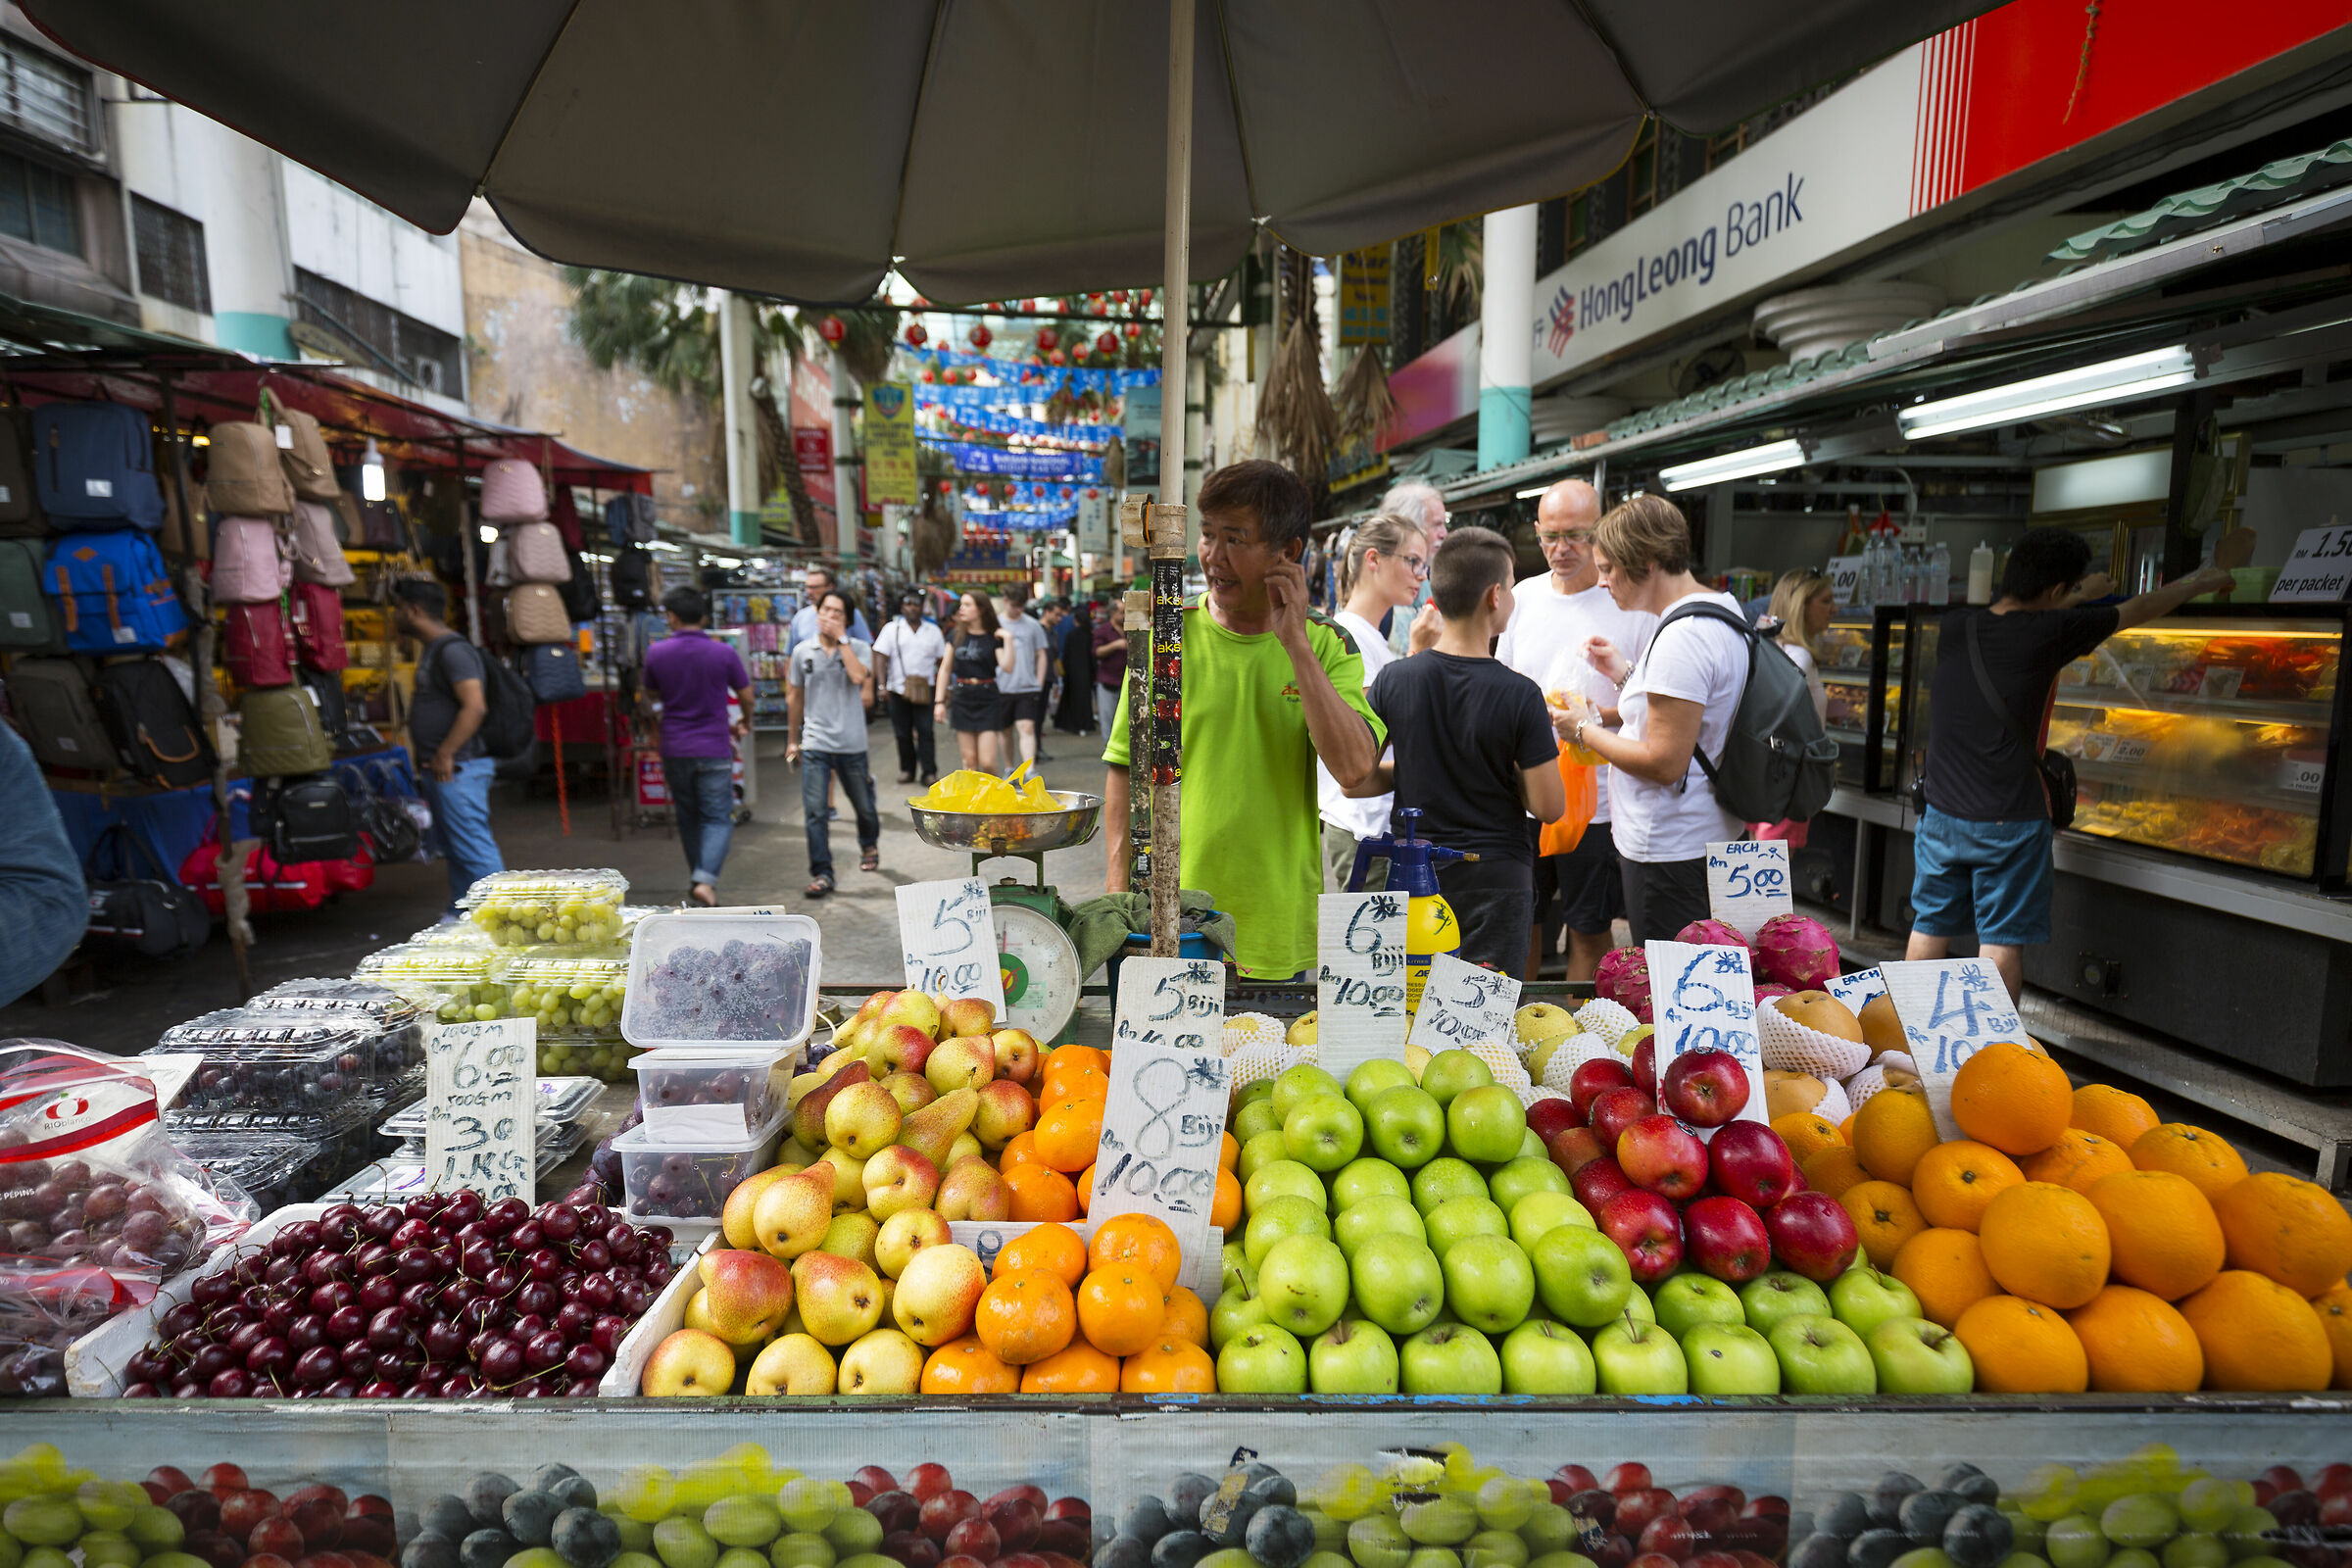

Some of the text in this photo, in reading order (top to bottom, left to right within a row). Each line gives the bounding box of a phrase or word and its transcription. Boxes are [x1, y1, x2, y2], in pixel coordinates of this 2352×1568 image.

[1726, 172, 1804, 258] Bank
[2274, 572, 2344, 595] per packet
[1726, 842, 1759, 854] EACH
[1725, 863, 1788, 898] 5.00
[927, 896, 973, 956] 5
[1346, 901, 1383, 955] 6
[921, 962, 981, 994] 10.00
[1372, 946, 1404, 977] Biji
[1673, 950, 1724, 1011] 6
[1842, 969, 1880, 986] EACH
[1149, 966, 1186, 1021] 5
[1186, 995, 1221, 1018] Biji
[1334, 977, 1404, 1017] 10.00
[1450, 975, 1488, 1007] 5
[1929, 970, 1993, 1037] 4
[453, 1041, 526, 1089] 6.00
[1133, 1057, 1192, 1160] 8
[1178, 1114, 1224, 1147] Biji
[1099, 1152, 1214, 1216] 10.00
